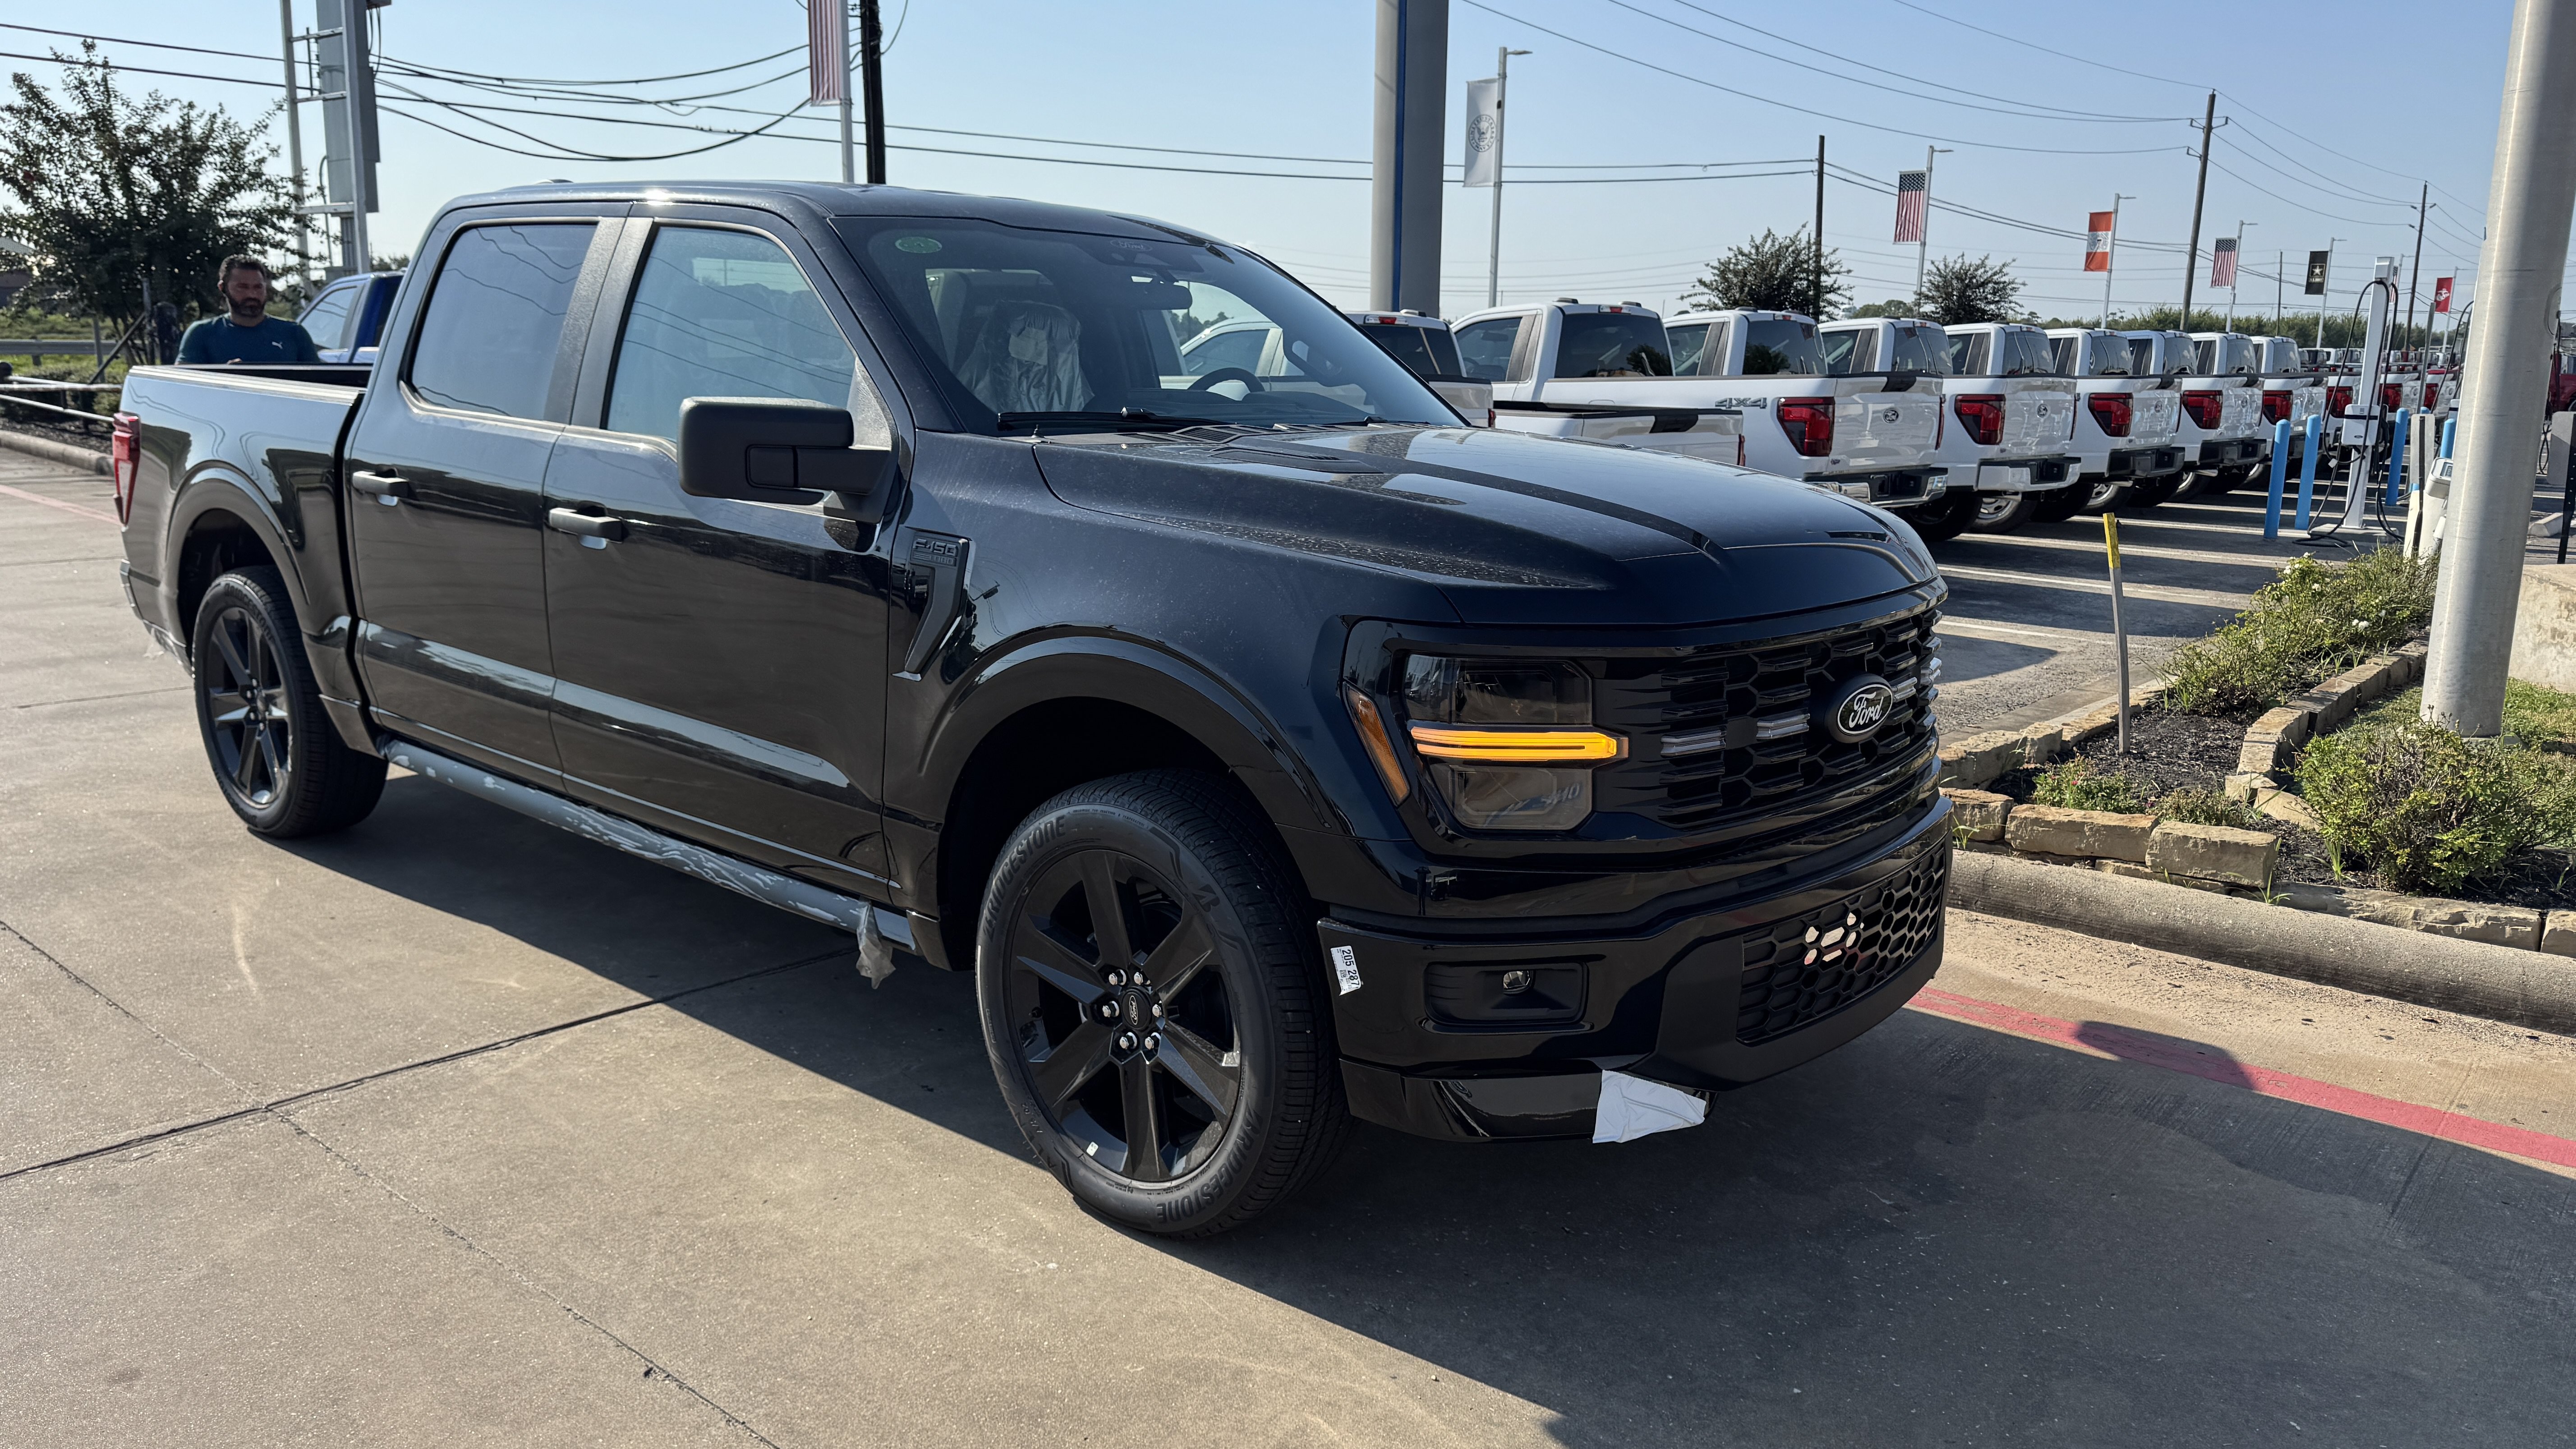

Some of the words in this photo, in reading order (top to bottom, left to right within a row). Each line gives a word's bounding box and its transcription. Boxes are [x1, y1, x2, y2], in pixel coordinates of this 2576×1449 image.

[913, 538, 958, 557] F-150
[930, 555, 954, 565] LOBO
[1849, 691, 1884, 728] Ford
[982, 814, 1066, 942] BRIDGESTONE
[1342, 949, 1354, 966] 205
[1155, 1100, 1264, 1223] BRIDGESTONE
